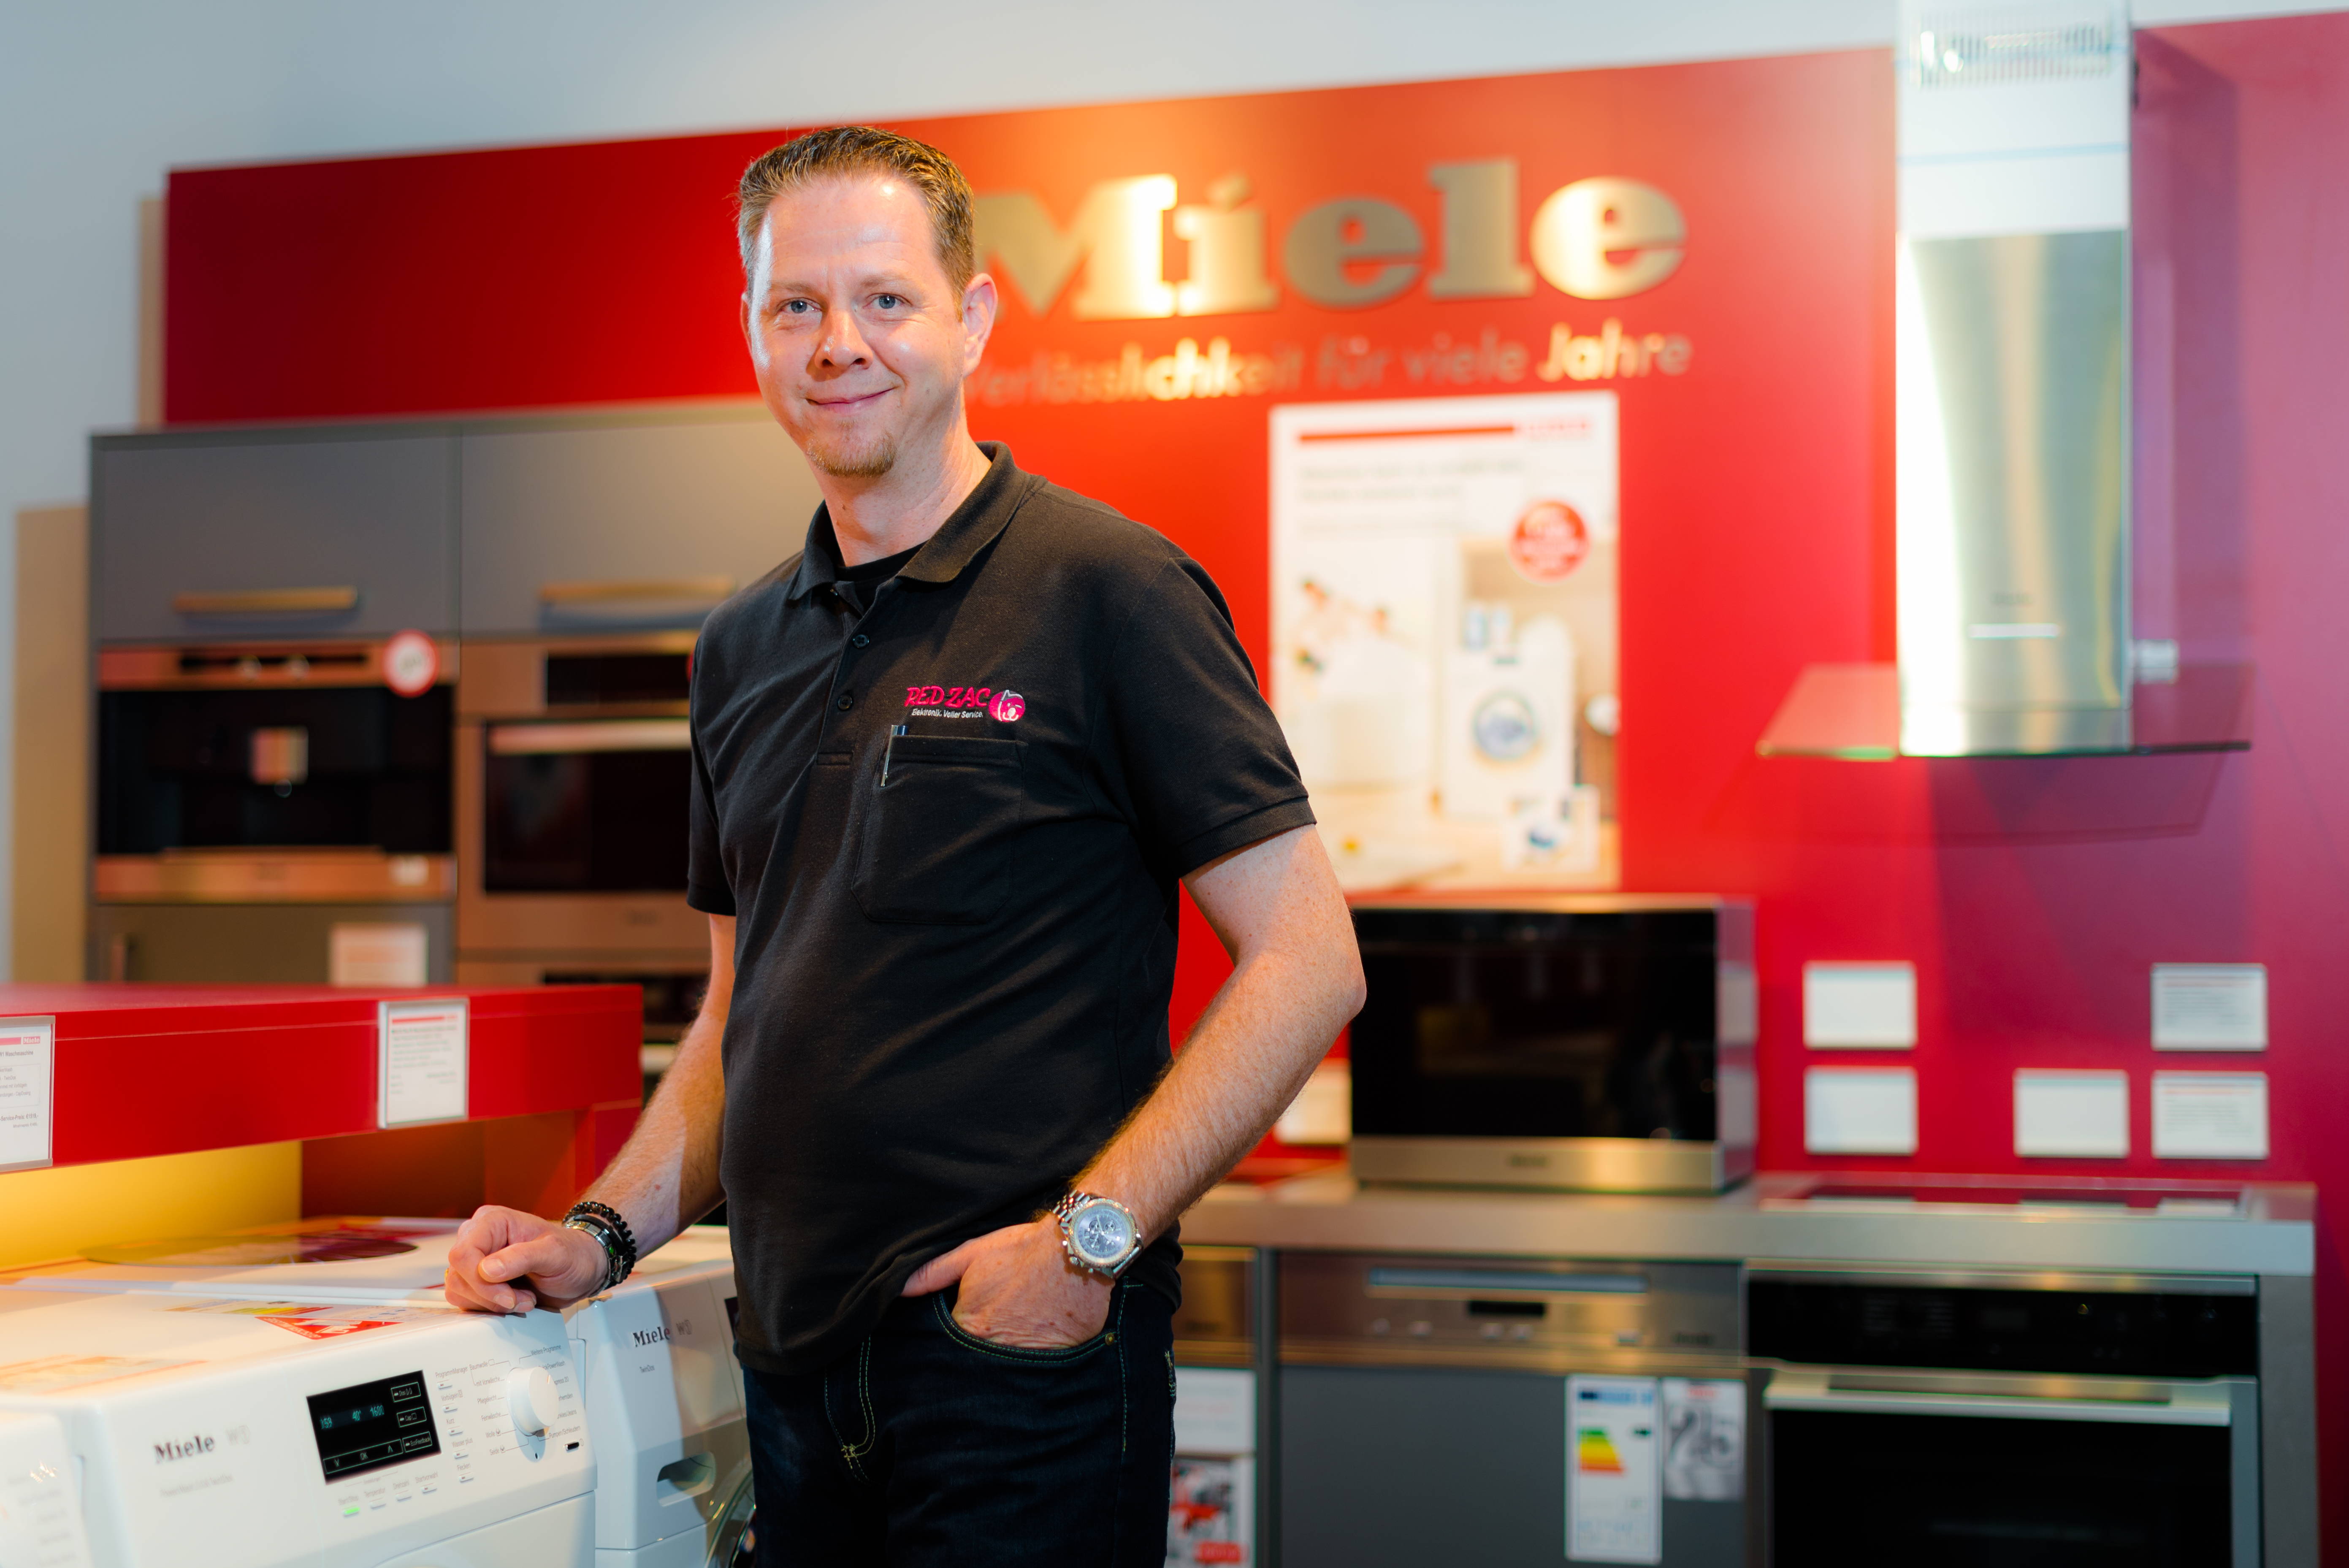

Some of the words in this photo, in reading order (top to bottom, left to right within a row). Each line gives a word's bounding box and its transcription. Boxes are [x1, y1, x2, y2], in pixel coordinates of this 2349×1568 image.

[973, 157, 1688, 320] Miele
[1401, 324, 1530, 387] viele
[1535, 317, 1692, 383] Jahre
[904, 685, 945, 707] RED
[944, 686, 991, 708] ZAC
[943, 710, 961, 718] Voller
[632, 1326, 671, 1348] Miele
[531, 1348, 543, 1356] Weitere
[543, 1345, 561, 1354] Programme
[469, 1361, 488, 1370] Baumwolle
[435, 1366, 468, 1378] ProgrammManager
[441, 1392, 459, 1401] Vorbügeln
[370, 1405, 385, 1417] 1600
[481, 1411, 501, 1421] Feinwäsche
[465, 1438, 473, 1446] plus
[154, 1434, 215, 1465] Miele
[489, 1448, 499, 1456] Seide
[360, 1452, 368, 1460] OK
[457, 1463, 471, 1471] Flecken
